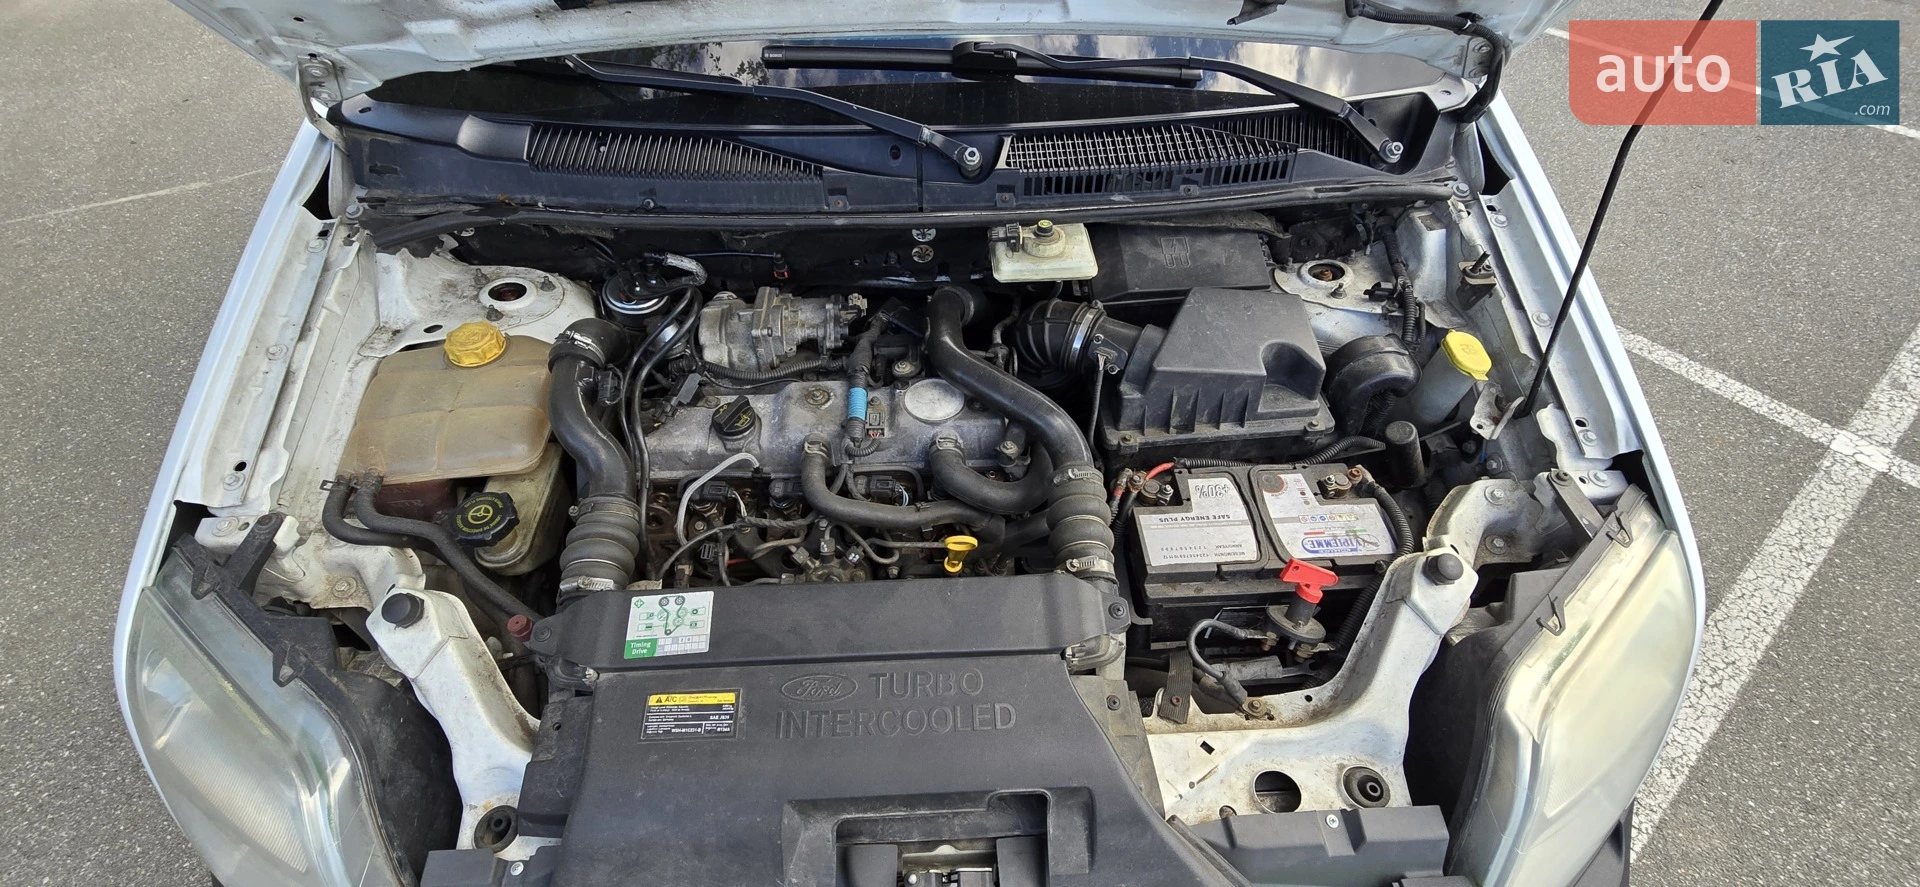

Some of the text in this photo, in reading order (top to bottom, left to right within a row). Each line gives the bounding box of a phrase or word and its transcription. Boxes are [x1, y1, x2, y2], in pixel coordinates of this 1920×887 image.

[1195, 484, 1230, 498] +30%
[796, 668, 984, 700] Ford TURBO
[775, 702, 1017, 740] INTERCOOLED
